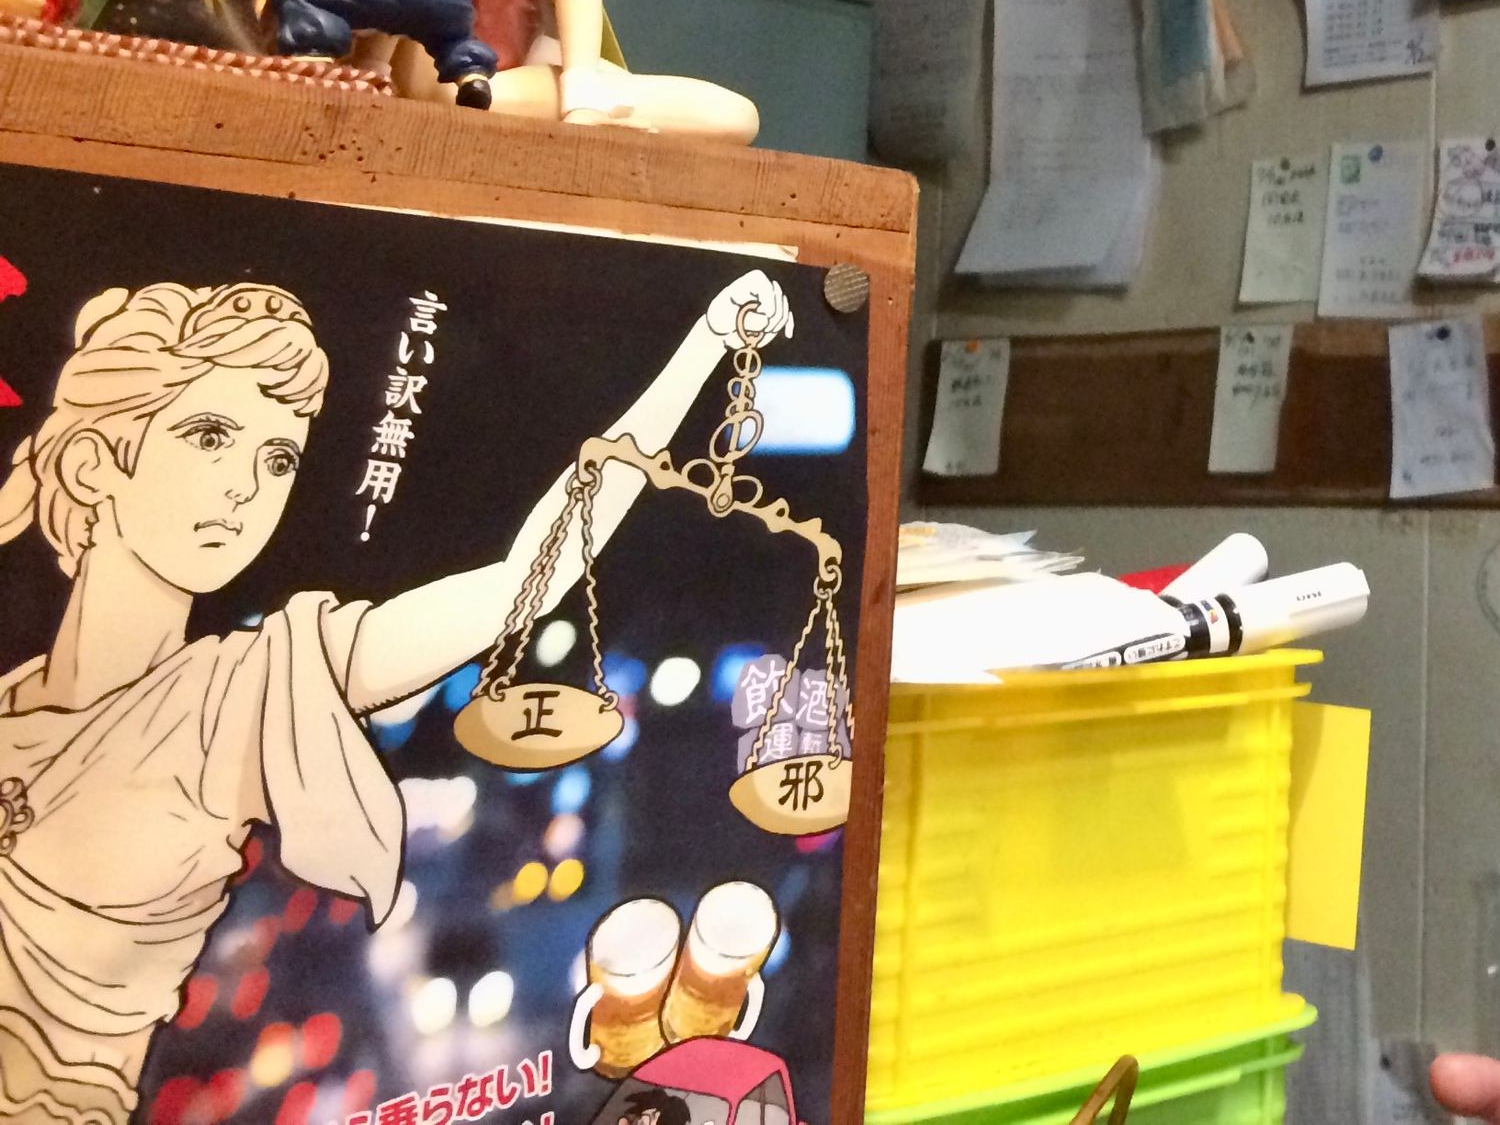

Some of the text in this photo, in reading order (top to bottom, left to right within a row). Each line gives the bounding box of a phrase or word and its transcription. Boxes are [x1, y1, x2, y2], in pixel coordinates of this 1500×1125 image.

[512, 691, 563, 741] 正
[740, 660, 838, 726] 飲酒
[778, 760, 824, 811] 邪
